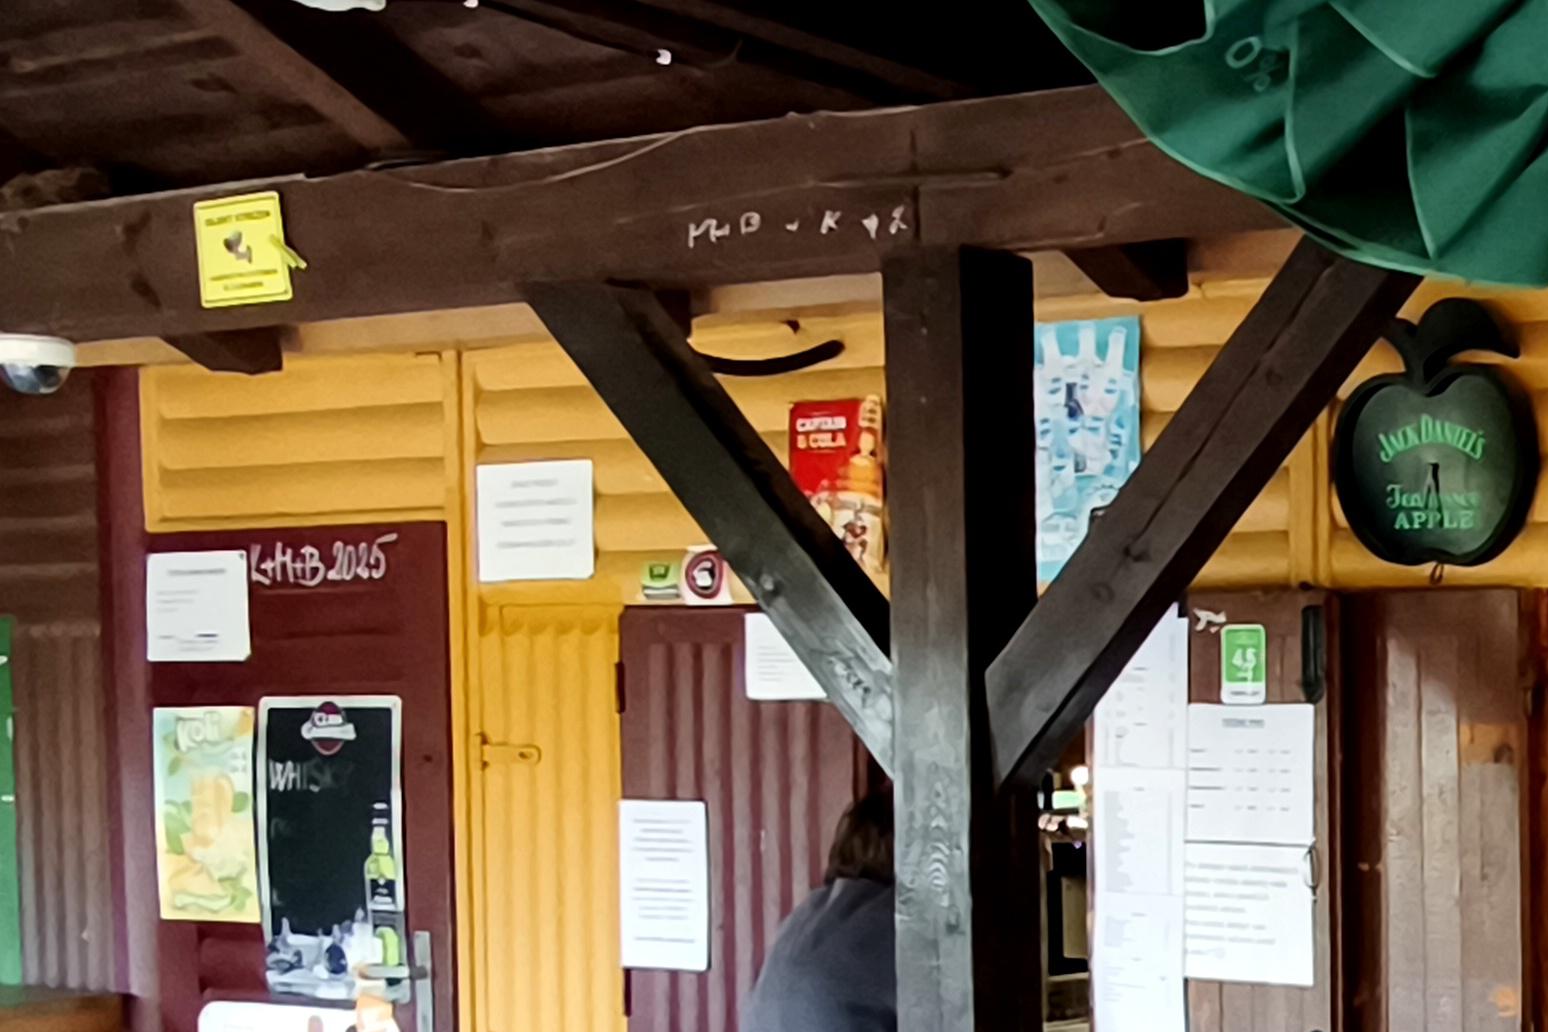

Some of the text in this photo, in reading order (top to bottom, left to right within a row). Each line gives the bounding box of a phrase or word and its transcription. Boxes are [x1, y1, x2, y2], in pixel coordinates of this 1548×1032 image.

[1378, 413, 1487, 463] JACK DANIEL'S
[1393, 510, 1476, 531] APPLE
[326, 532, 399, 580] 2025
